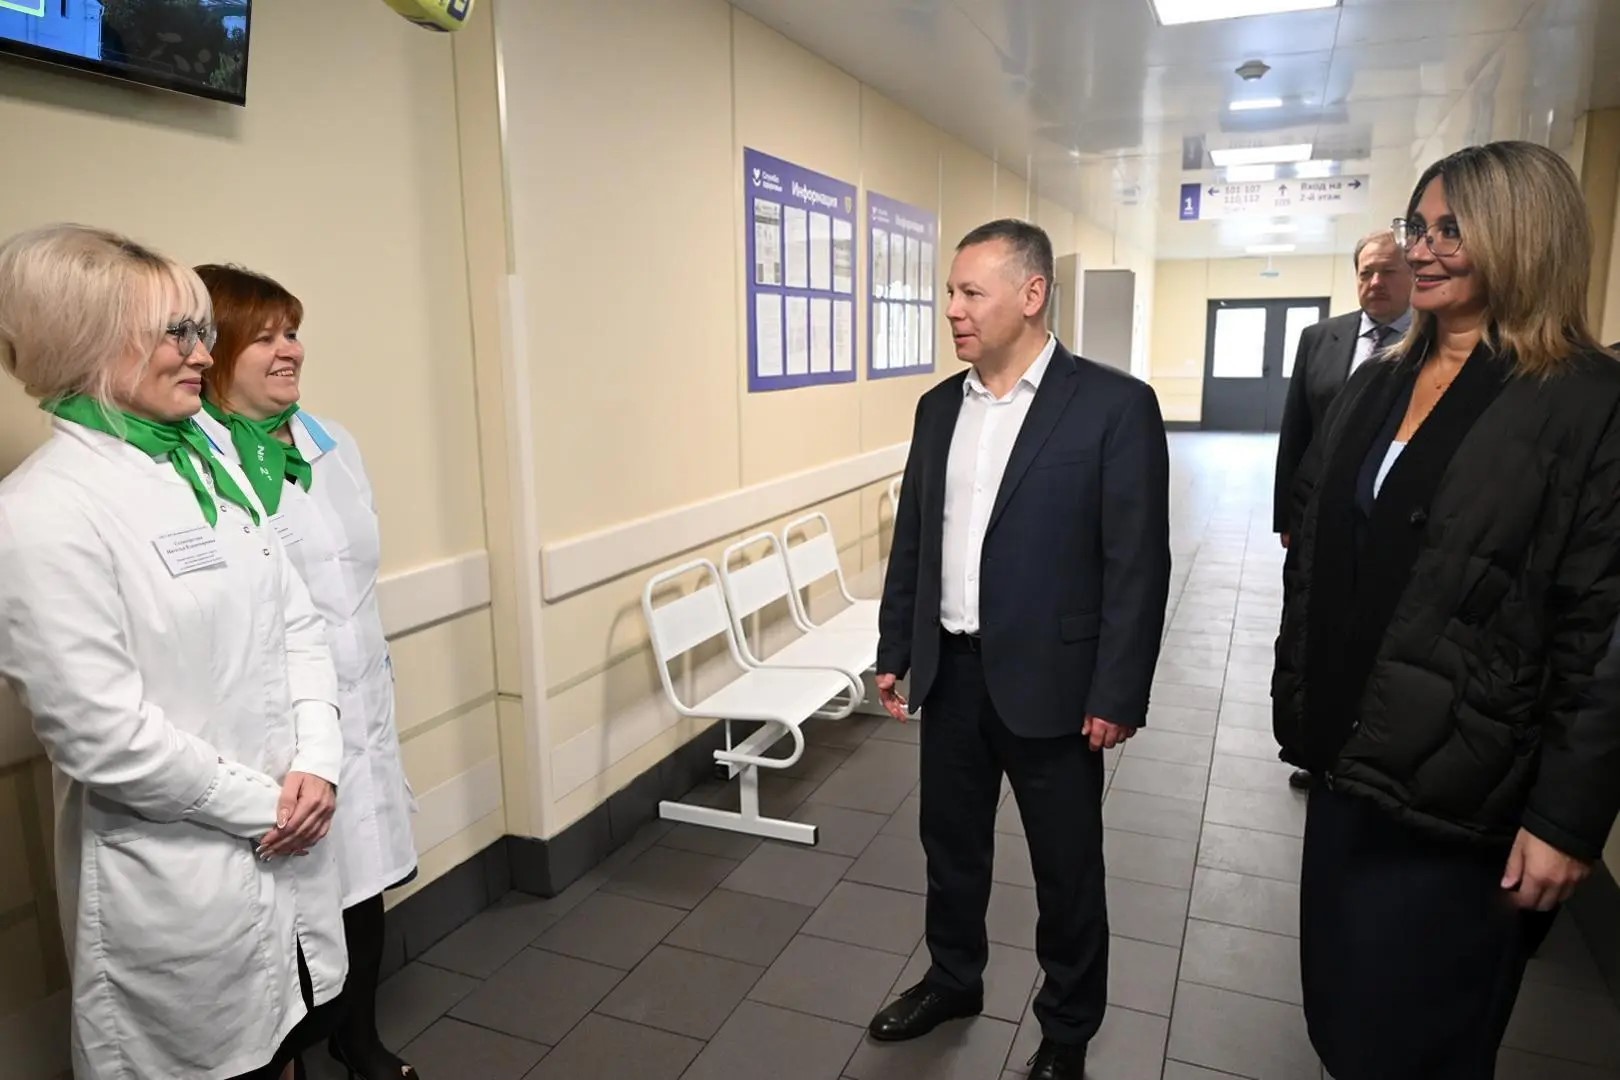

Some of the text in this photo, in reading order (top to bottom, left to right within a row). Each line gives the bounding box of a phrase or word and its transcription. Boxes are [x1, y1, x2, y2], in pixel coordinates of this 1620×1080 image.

[791, 180, 838, 208] Информация
[1301, 182, 1342, 192] Вход на
[1184, 196, 1193, 210] 1
